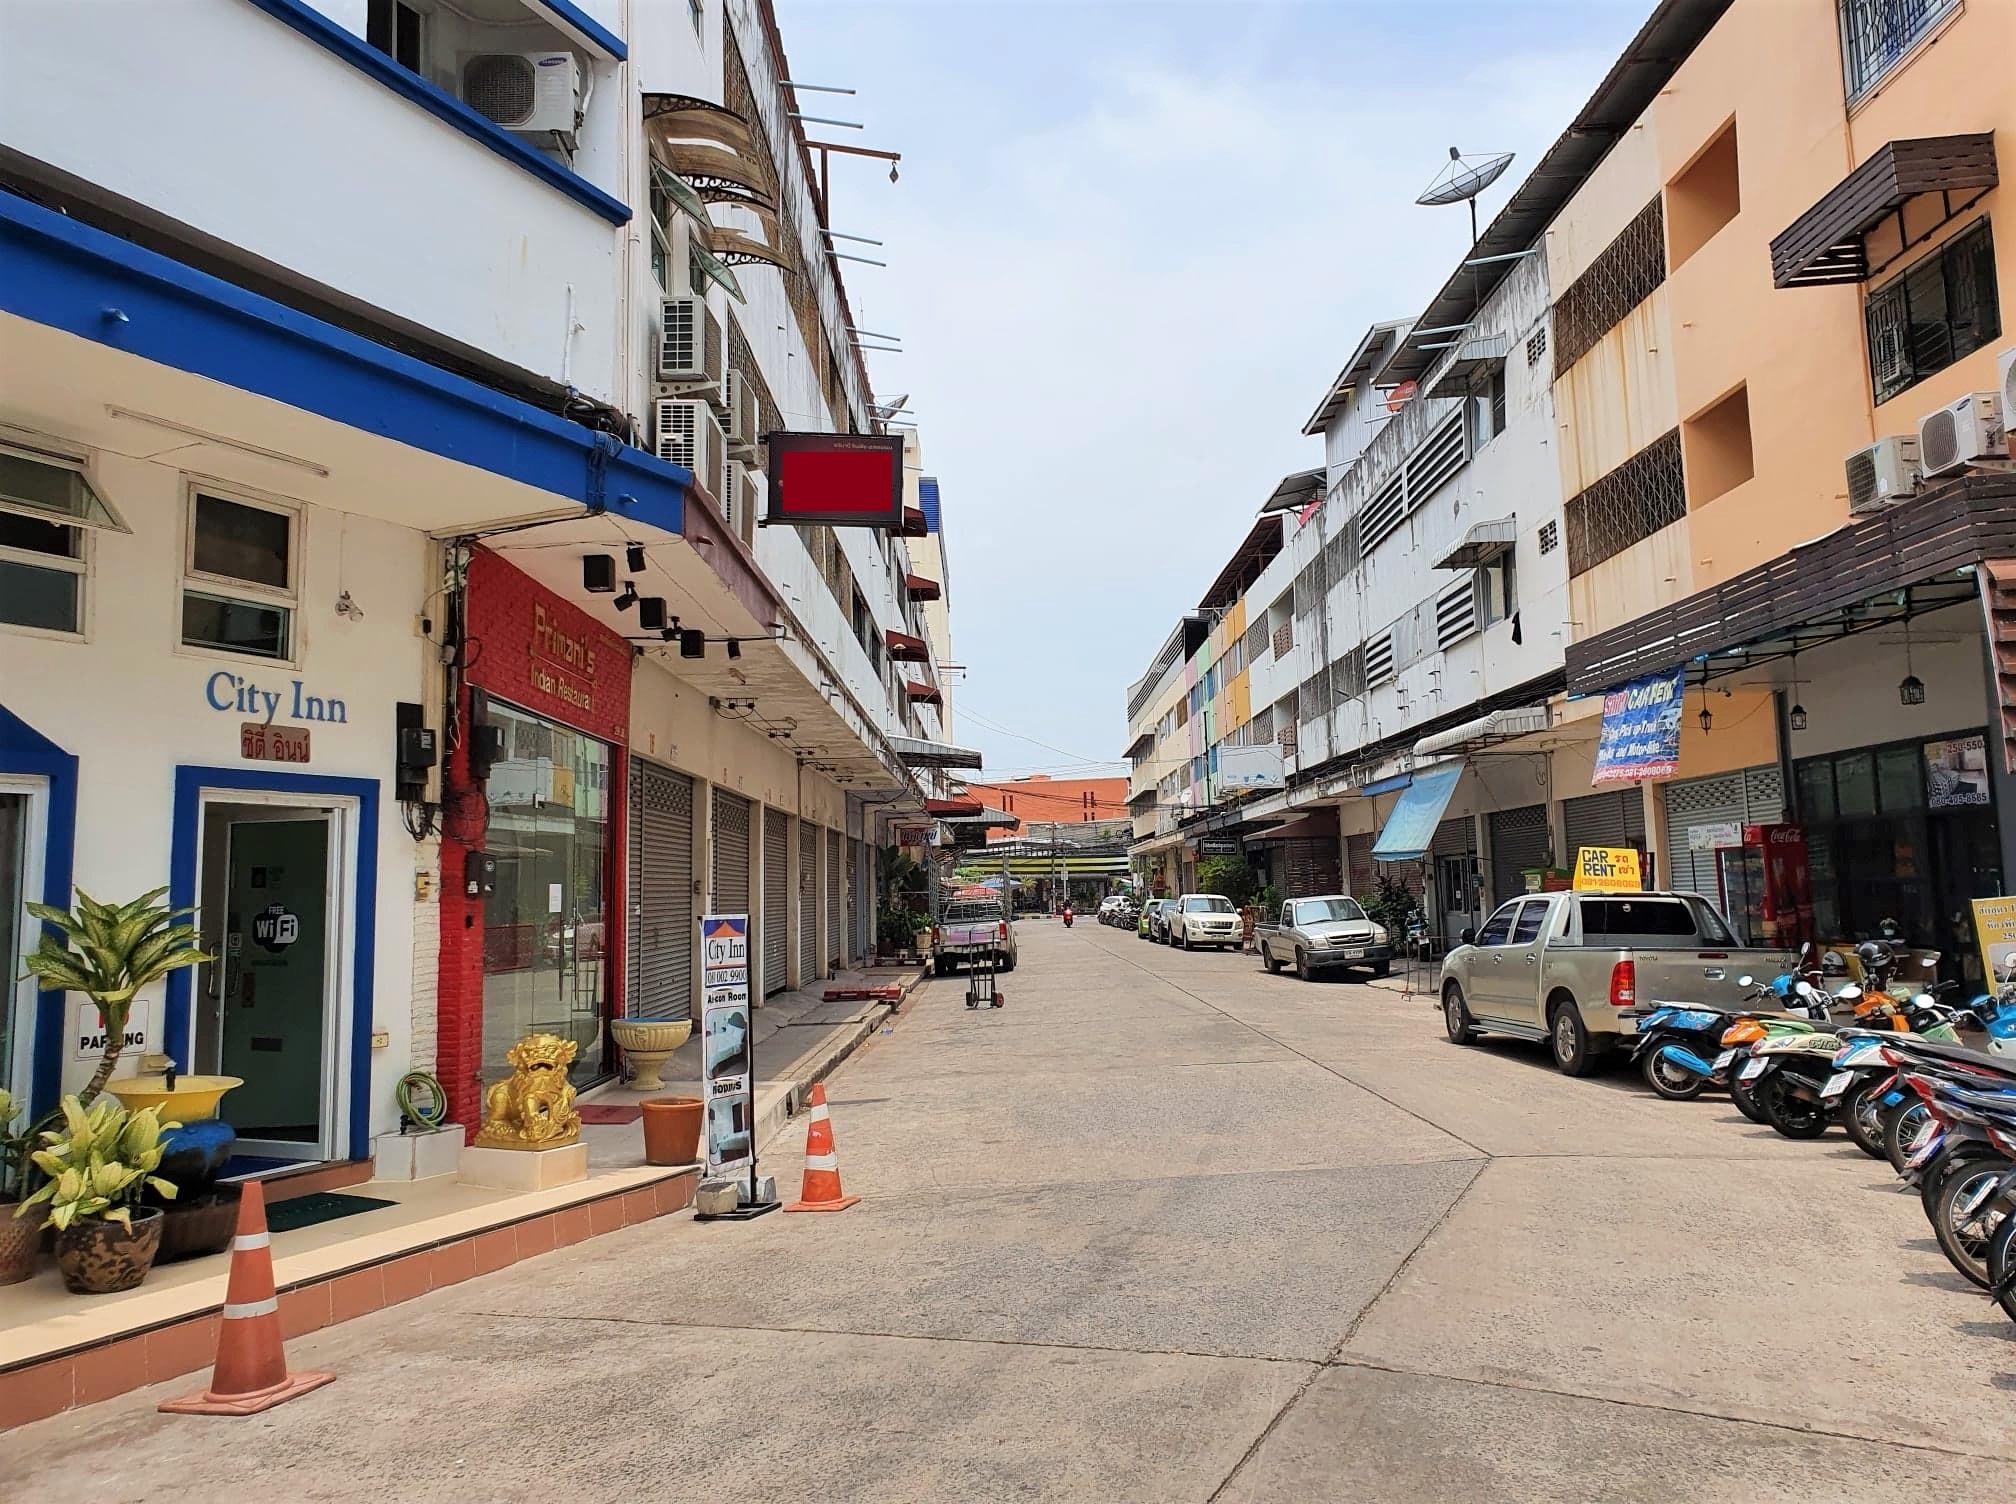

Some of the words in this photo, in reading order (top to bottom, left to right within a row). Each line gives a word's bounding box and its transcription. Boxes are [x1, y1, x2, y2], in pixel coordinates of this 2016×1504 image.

[534, 602, 596, 674] Primani's
[530, 663, 556, 696] Indian
[558, 677, 596, 713] Restaurat
[206, 671, 282, 730] City
[291, 680, 348, 723] Inn
[1582, 849, 1609, 864] CAR
[1583, 863, 1617, 878] RENT
[268, 905, 285, 915] FREE
[729, 938, 745, 958] Inn
[80, 1031, 145, 1050] PANG
